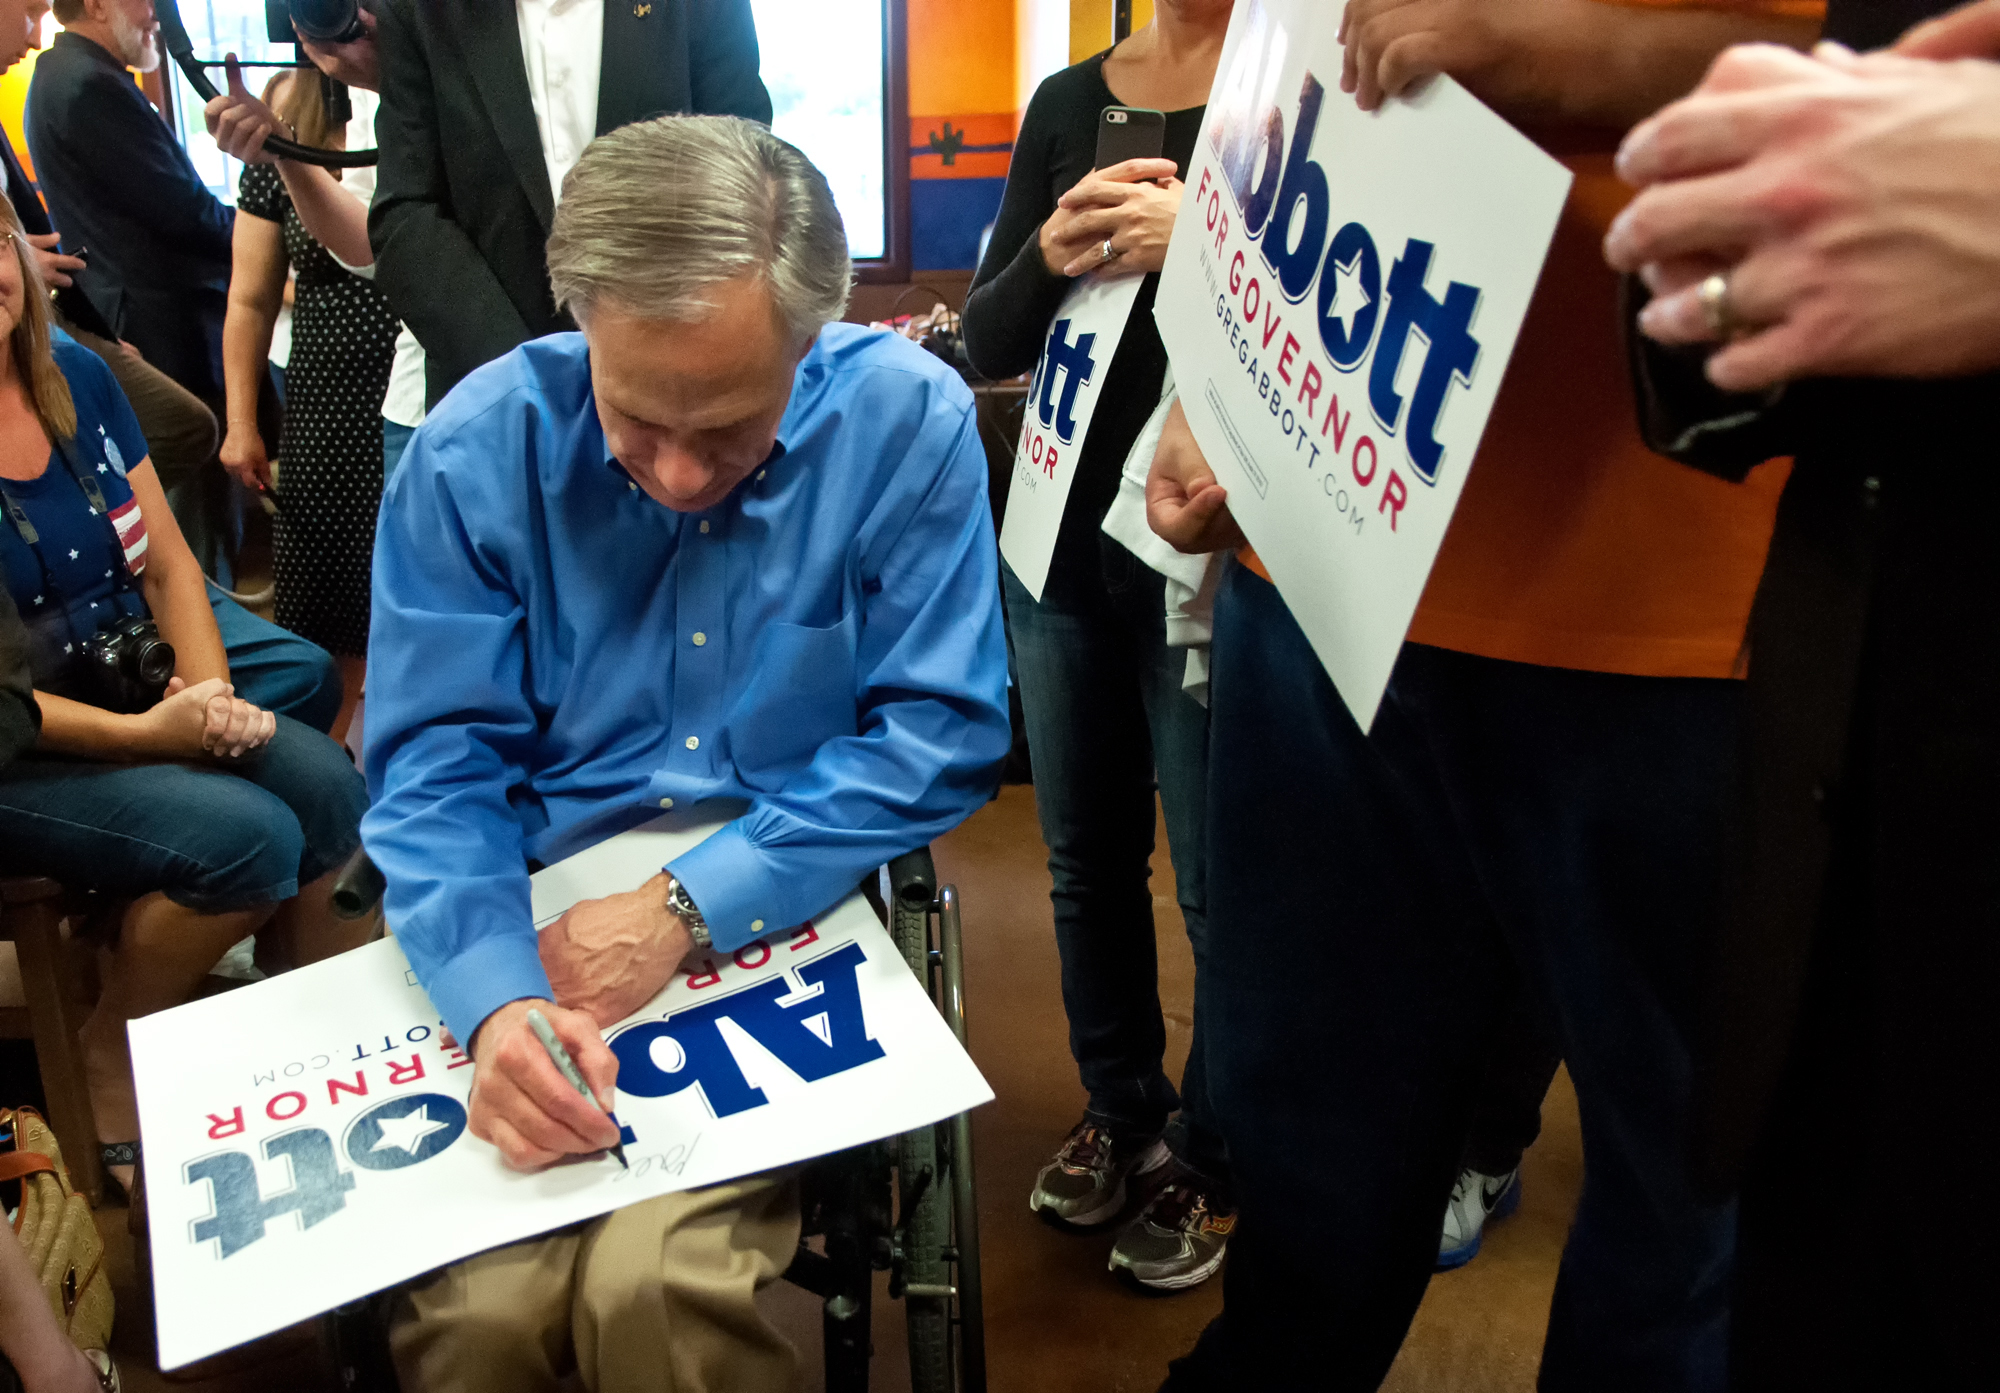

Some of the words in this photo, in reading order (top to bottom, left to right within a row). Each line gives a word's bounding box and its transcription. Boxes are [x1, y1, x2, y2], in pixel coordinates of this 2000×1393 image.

[1197, 166, 1229, 260] FOR
[1229, 250, 1408, 533] GOVERNOR
[1200, 244, 1366, 536] WWW.GREGABBOTT.COM
[686, 920, 819, 990] FOR
